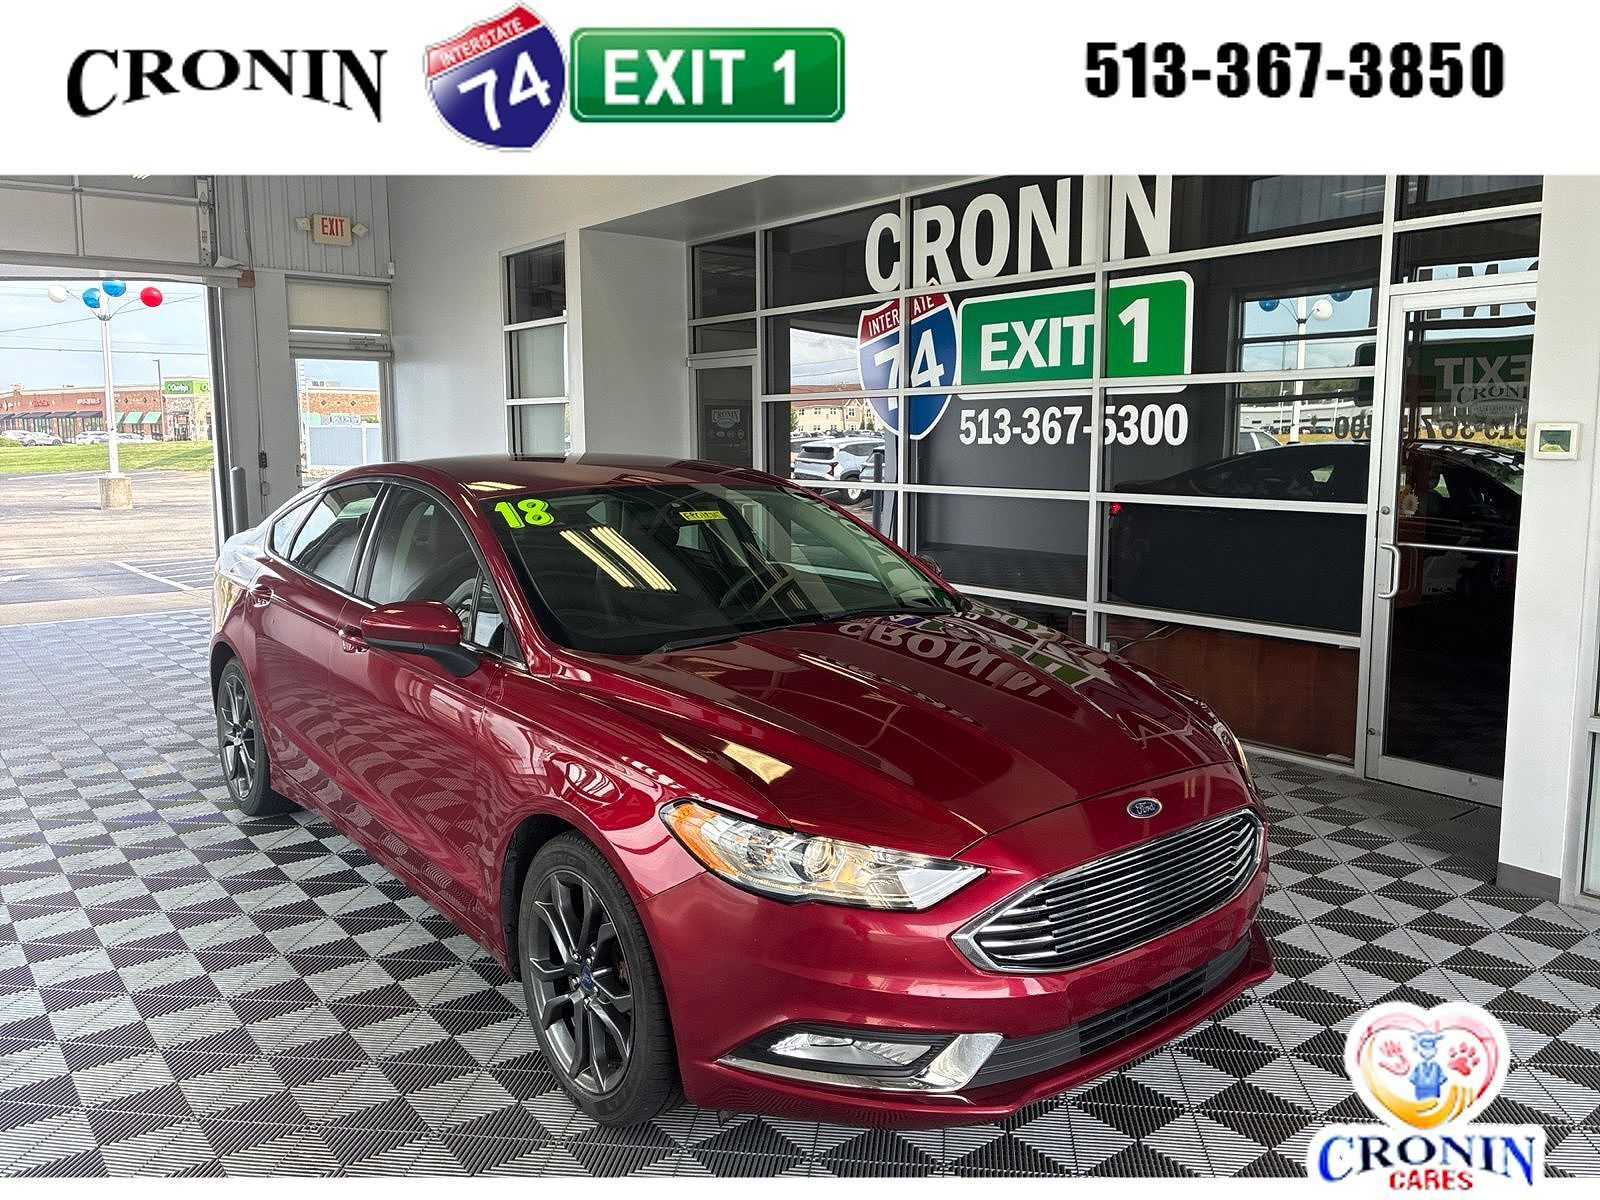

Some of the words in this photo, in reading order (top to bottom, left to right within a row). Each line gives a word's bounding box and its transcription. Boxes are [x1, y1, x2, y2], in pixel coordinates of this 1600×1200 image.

[321, 217, 345, 237] EXIT
[865, 175, 1172, 293] CRONIN
[980, 313, 1095, 372] EXIT
[1117, 297, 1150, 363] 1
[873, 329, 945, 411] 74
[959, 403, 1189, 446] 513-367-5300
[495, 499, 554, 528] 18
